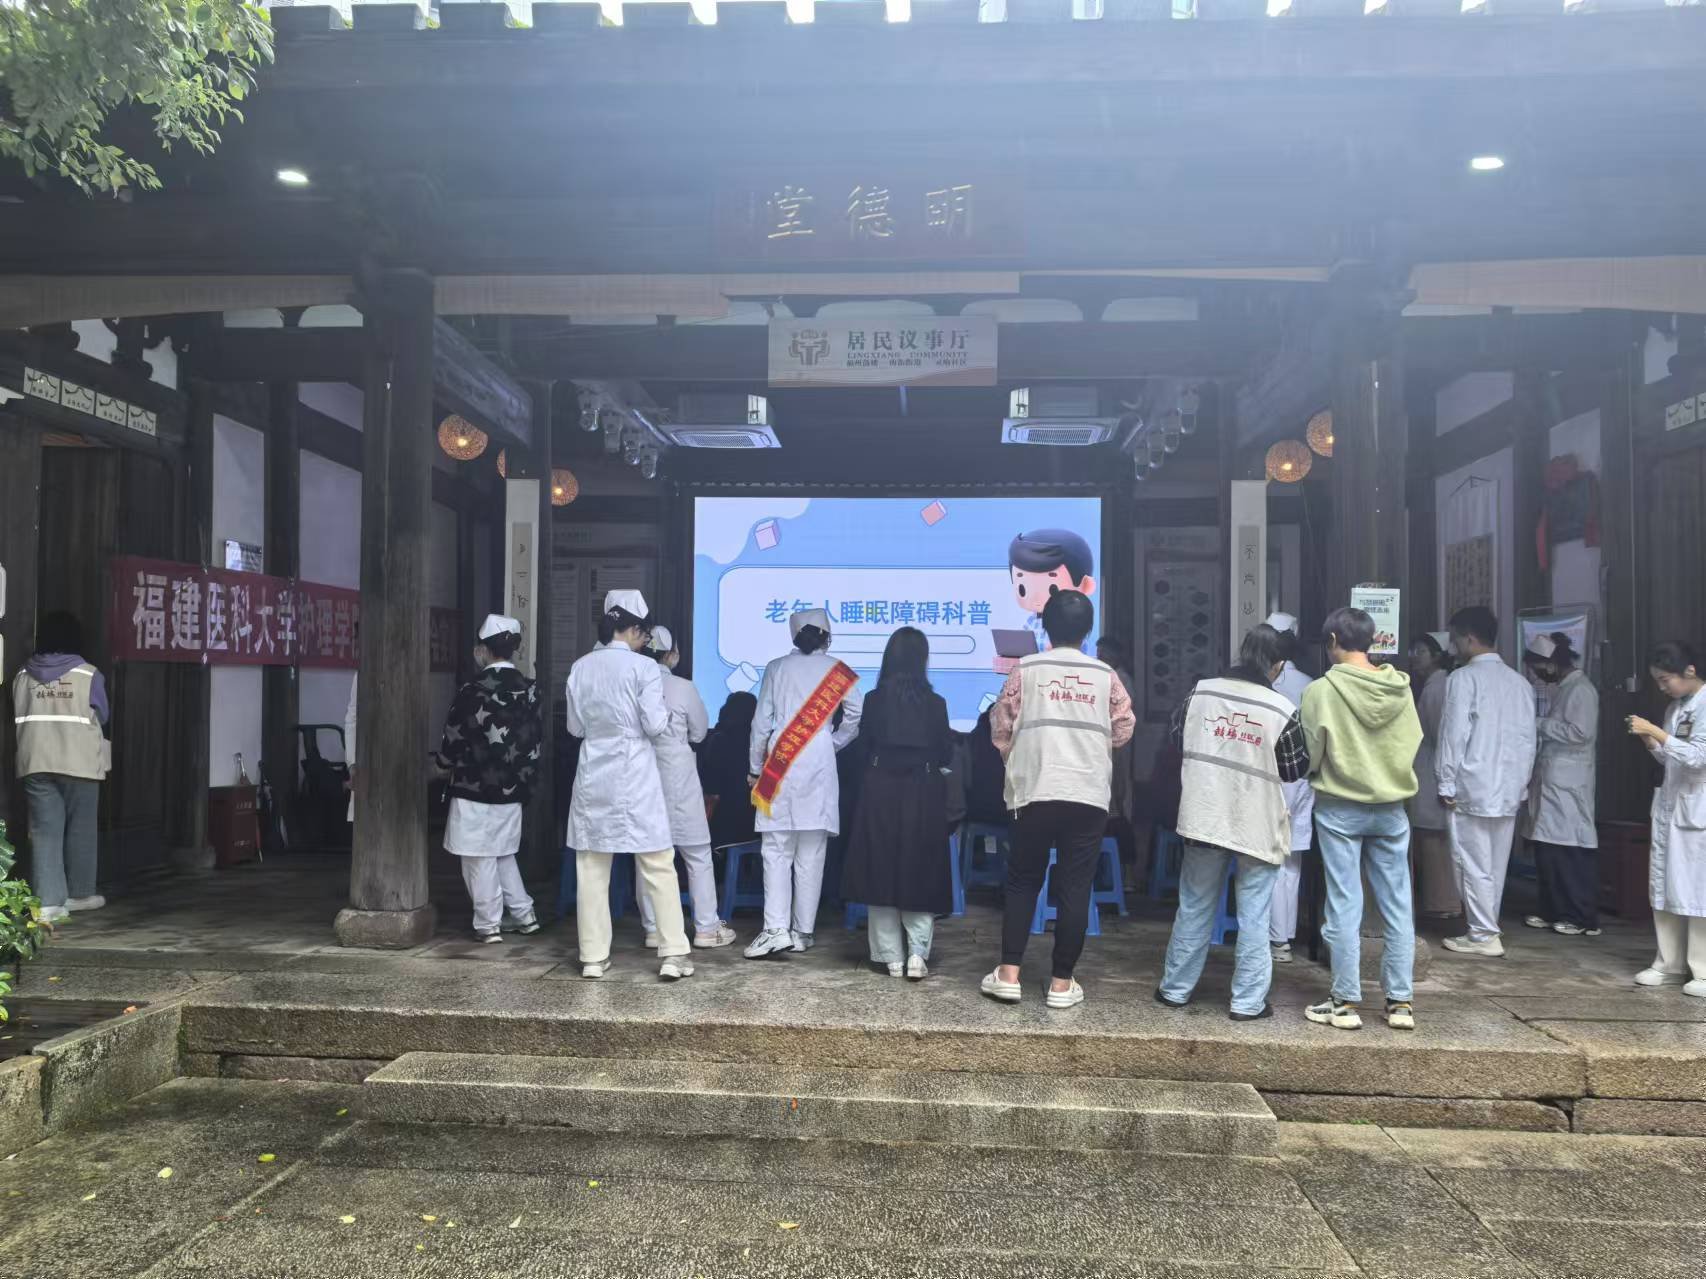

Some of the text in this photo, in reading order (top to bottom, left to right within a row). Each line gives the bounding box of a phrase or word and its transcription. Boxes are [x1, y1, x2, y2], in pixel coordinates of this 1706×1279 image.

[847, 330, 970, 351] 居民议事厅
[910, 352, 968, 360] COMMUNITY
